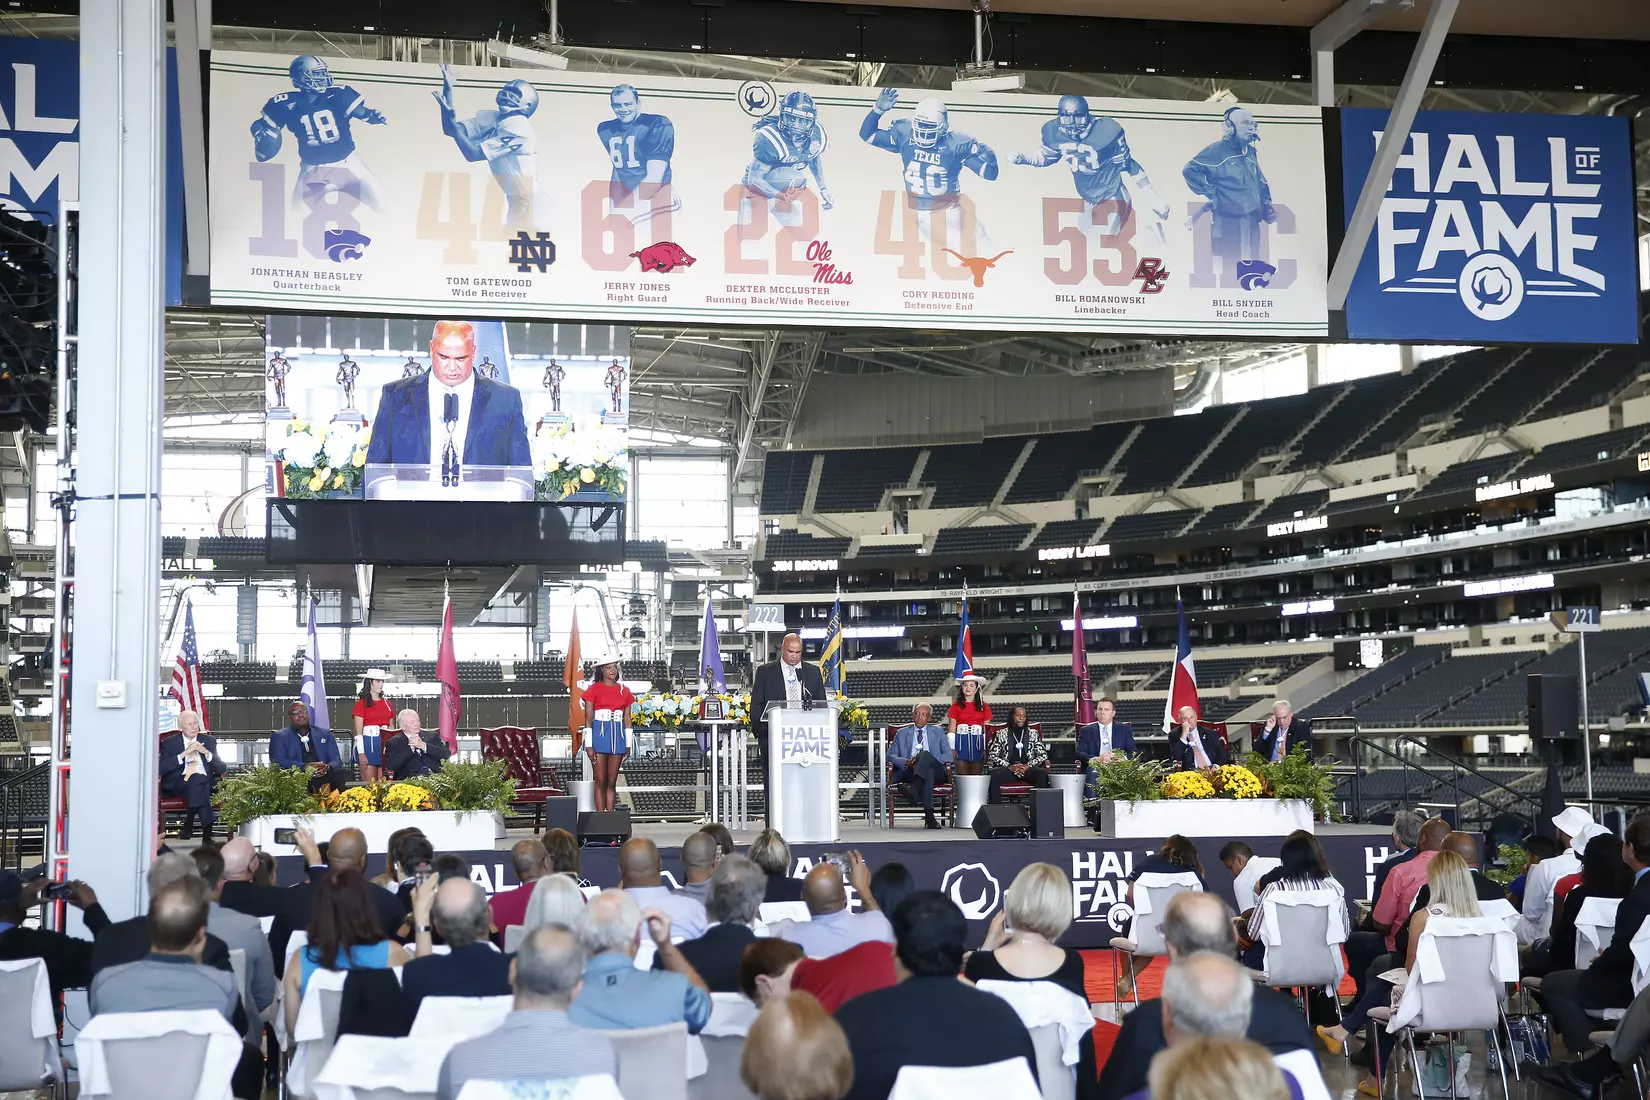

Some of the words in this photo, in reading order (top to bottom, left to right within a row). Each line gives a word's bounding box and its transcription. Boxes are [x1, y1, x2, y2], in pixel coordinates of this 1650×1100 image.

[300, 109, 340, 146] 18
[608, 135, 640, 168] 61
[913, 149, 941, 174] TEXAS
[1059, 143, 1100, 175] 53
[1373, 131, 1601, 197] HALL
[1575, 153, 1601, 169] OF
[905, 161, 948, 196] 40
[249, 162, 361, 260] 18
[581, 180, 684, 274] 61
[724, 184, 820, 276] 22
[874, 190, 978, 281] 40
[1042, 197, 1138, 287] 53
[806, 240, 832, 261] Ole
[1377, 198, 1605, 291] FAME
[250, 267, 310, 278] JONATHAN
[313, 271, 363, 281] BEASLEY
[813, 263, 853, 285] Miss
[273, 280, 341, 292] Quarterback
[446, 277, 469, 286] TOM
[473, 278, 532, 288] GATEWOOD
[604, 282, 635, 291] JERRY
[639, 283, 671, 292] JONES
[726, 284, 766, 293] DEXTER
[769, 285, 830, 295] MCCLUSTER
[451, 288, 477, 297] Wide
[481, 289, 527, 298] Receiver
[606, 293, 634, 302] Right
[638, 294, 668, 303] Guard
[902, 290, 928, 299] CORY
[931, 291, 975, 300] REDDING
[1055, 294, 1076, 302] BILL
[1079, 295, 1146, 304] ROMANOWSKI
[705, 295, 747, 305] Running
[750, 296, 804, 306] Back/Wide
[807, 297, 851, 307] Receiver
[904, 301, 952, 310] Defensive
[955, 302, 973, 310] End
[1212, 299, 1233, 307] BILL
[1235, 300, 1273, 308] SNYDER
[1074, 305, 1127, 314] Linebacker
[1216, 310, 1239, 318] Head
[1242, 310, 1270, 318] Coach
[161, 559, 202, 570] HALL
[794, 560, 839, 571] BROWN
[949, 589, 978, 597] RAYFELD
[755, 606, 779, 624] 222
[1572, 608, 1593, 625] 221
[781, 727, 831, 740] HALL
[781, 741, 831, 759] FAME
